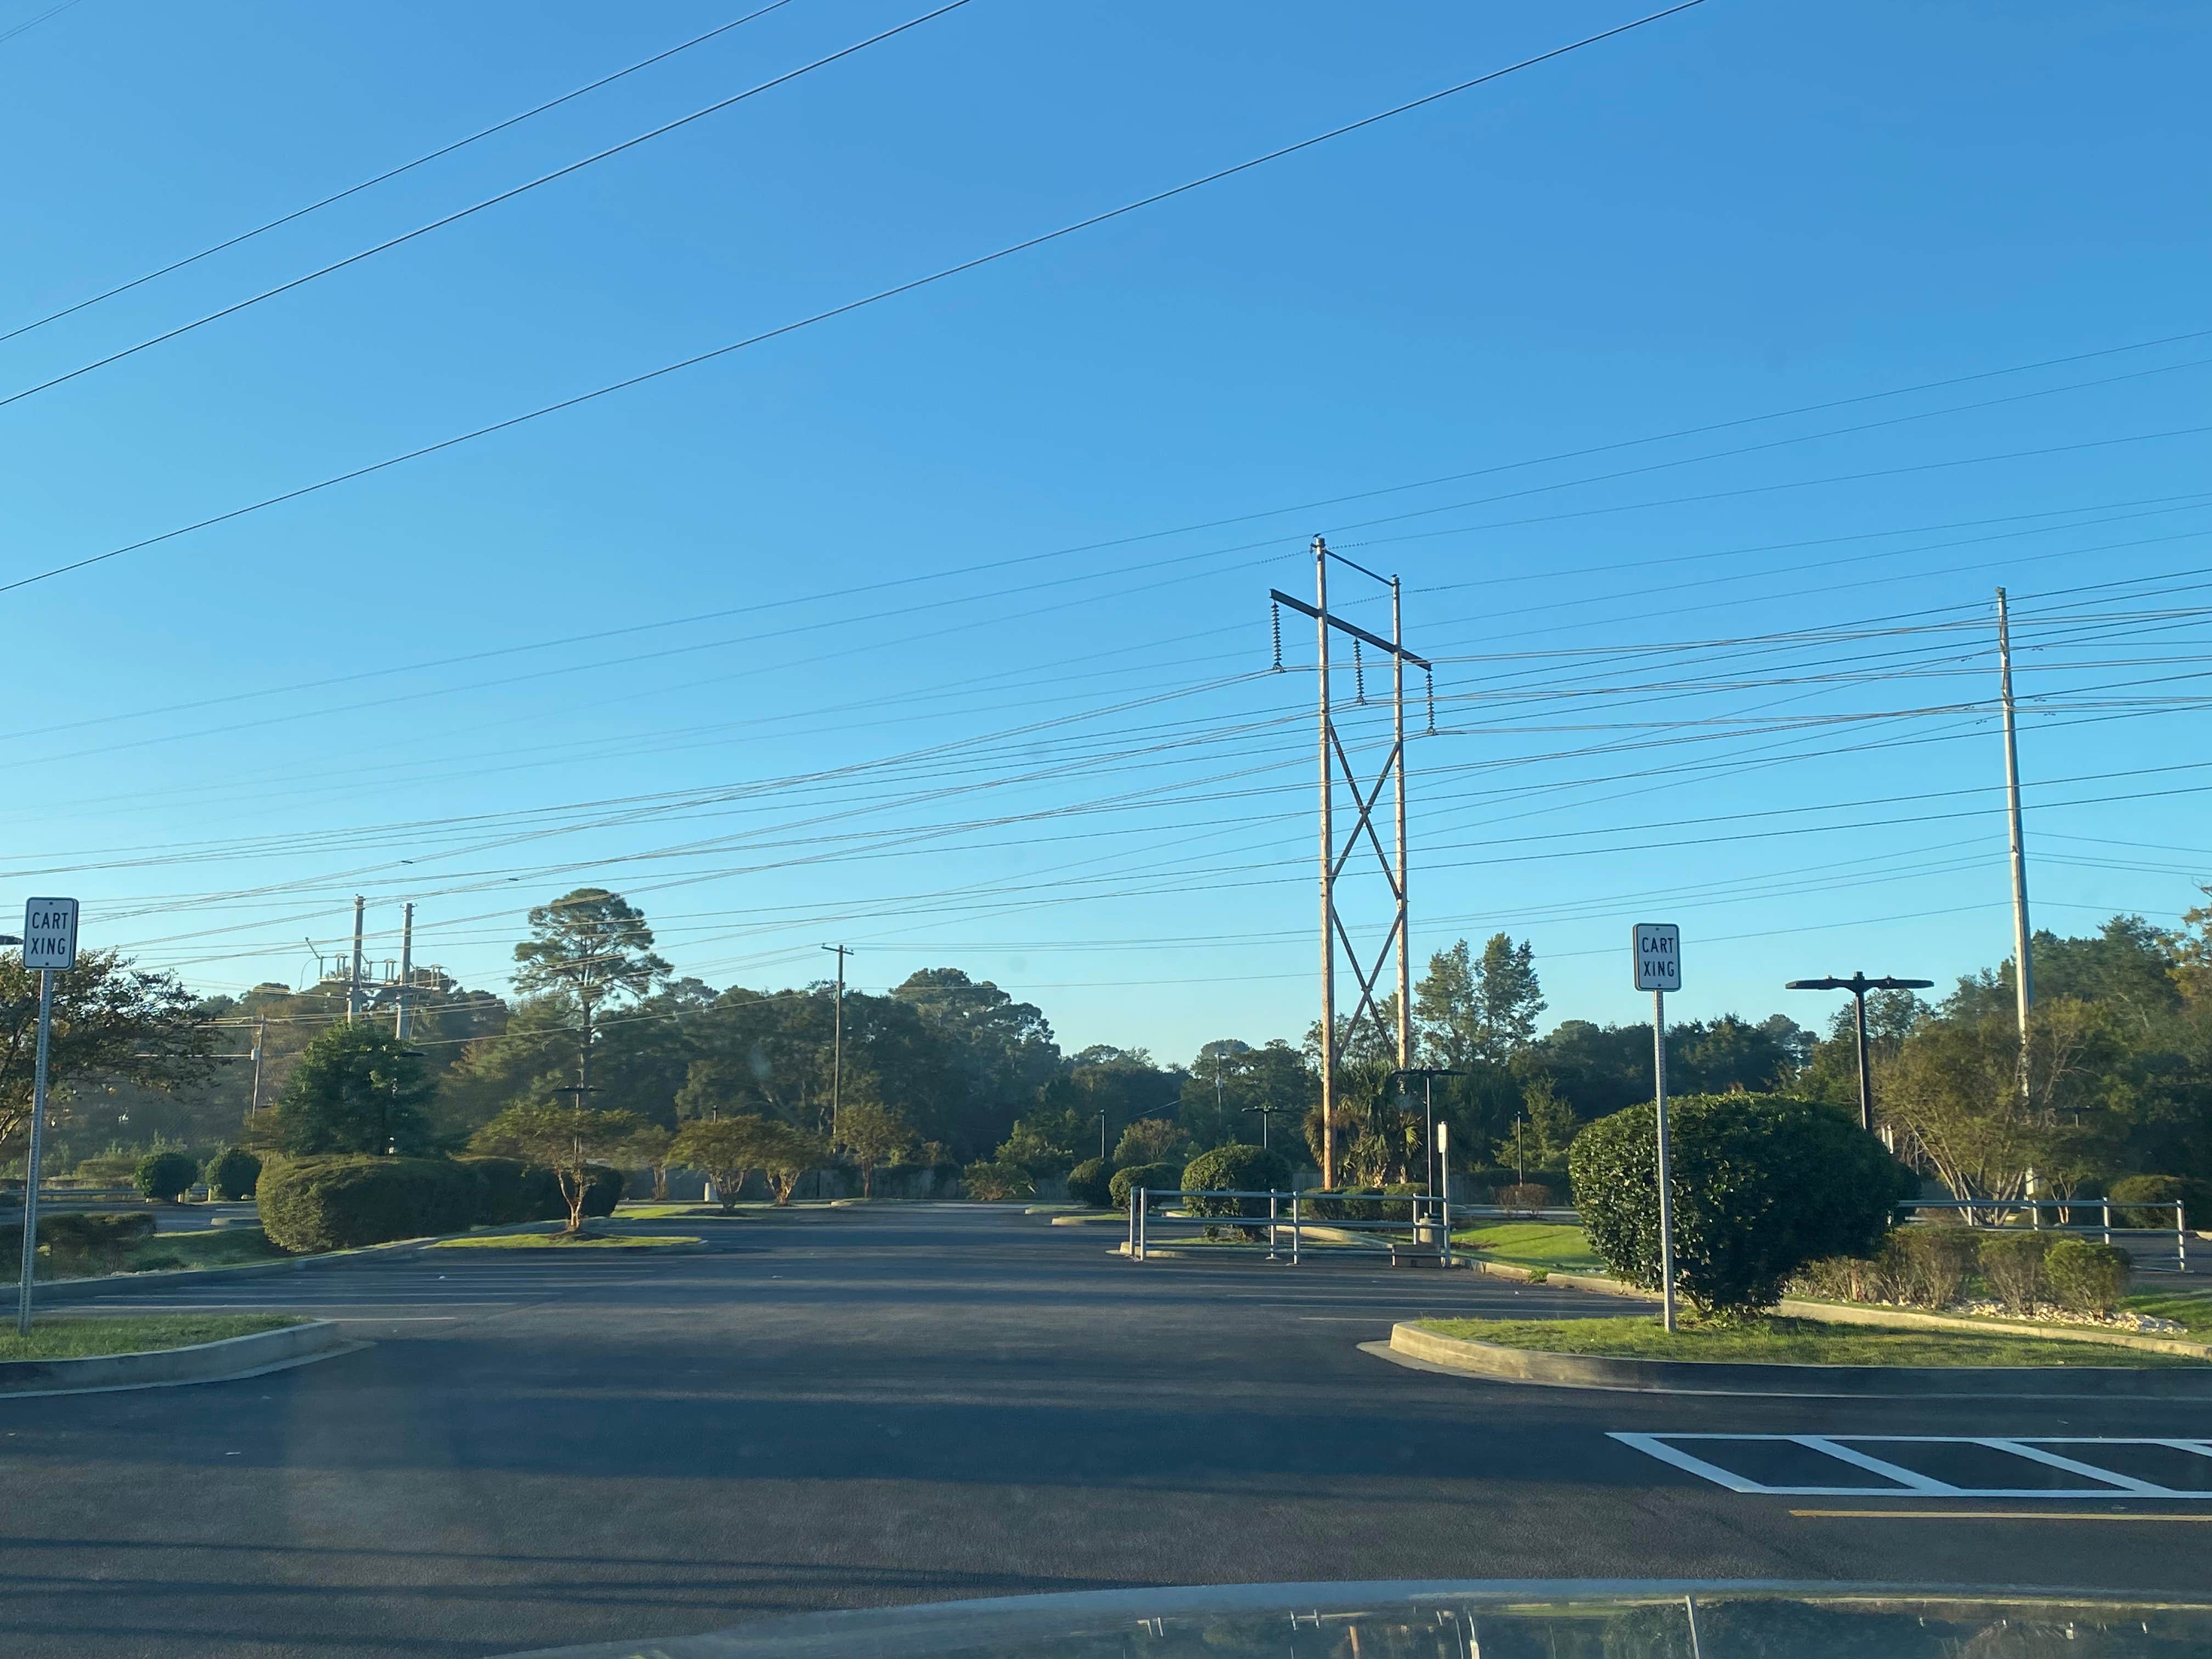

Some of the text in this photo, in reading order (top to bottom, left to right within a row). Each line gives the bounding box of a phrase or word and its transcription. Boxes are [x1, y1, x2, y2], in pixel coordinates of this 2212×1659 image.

[32, 912, 68, 929] CART
[31, 938, 65, 955] XING
[1642, 937, 1673, 953] CART
[1644, 961, 1674, 977] XING
